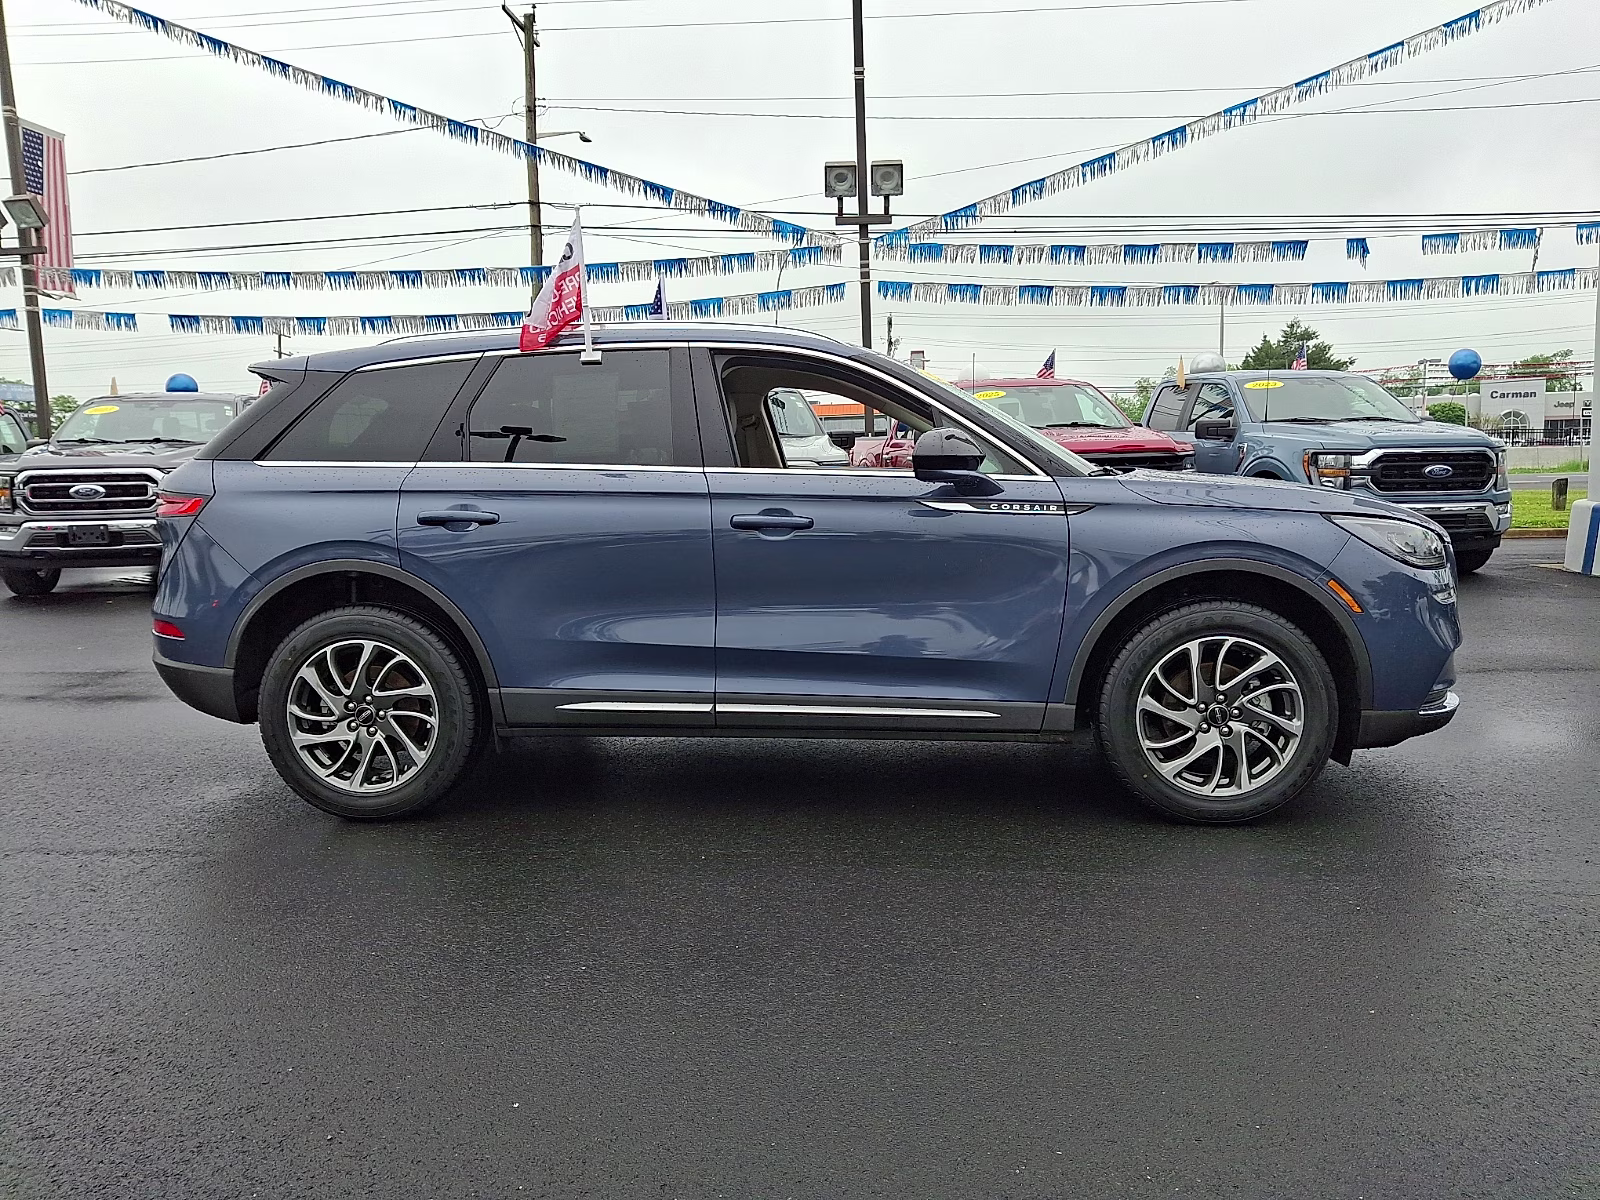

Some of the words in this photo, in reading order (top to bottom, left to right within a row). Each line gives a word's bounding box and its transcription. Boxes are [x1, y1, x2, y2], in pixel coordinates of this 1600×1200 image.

[1490, 390, 1537, 399] Carman
[1553, 400, 1575, 408] Jeep
[989, 503, 1058, 511] CORSAIR
